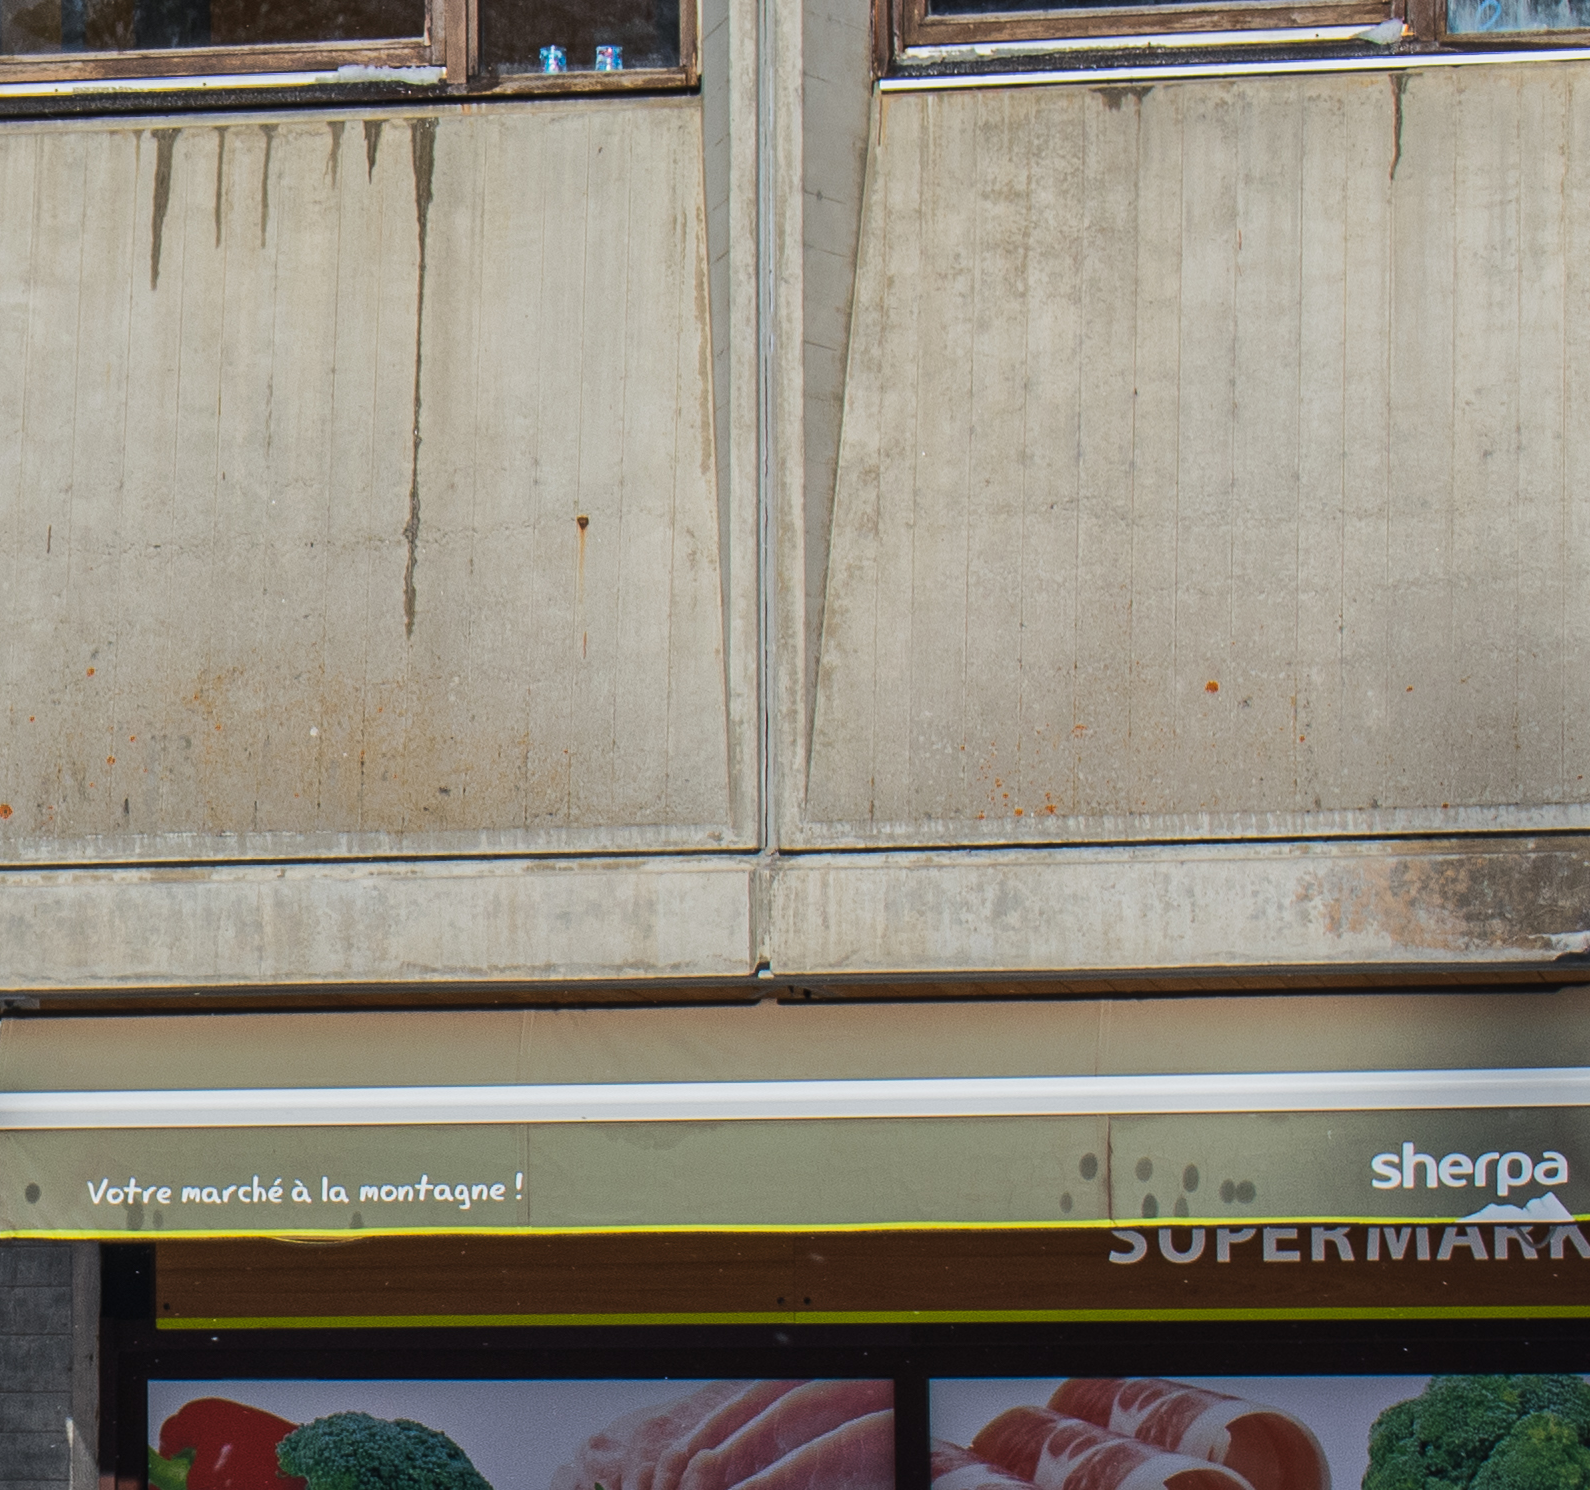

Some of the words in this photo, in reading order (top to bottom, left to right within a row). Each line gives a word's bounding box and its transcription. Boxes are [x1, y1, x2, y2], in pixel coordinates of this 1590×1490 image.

[87, 1177, 171, 1204] Votre
[182, 1174, 282, 1204] marché
[292, 1179, 312, 1204] à
[322, 1175, 349, 1204] la
[359, 1173, 505, 1209] montagne
[514, 1172, 523, 1200] !
[1371, 1142, 1568, 1197] sherpa
